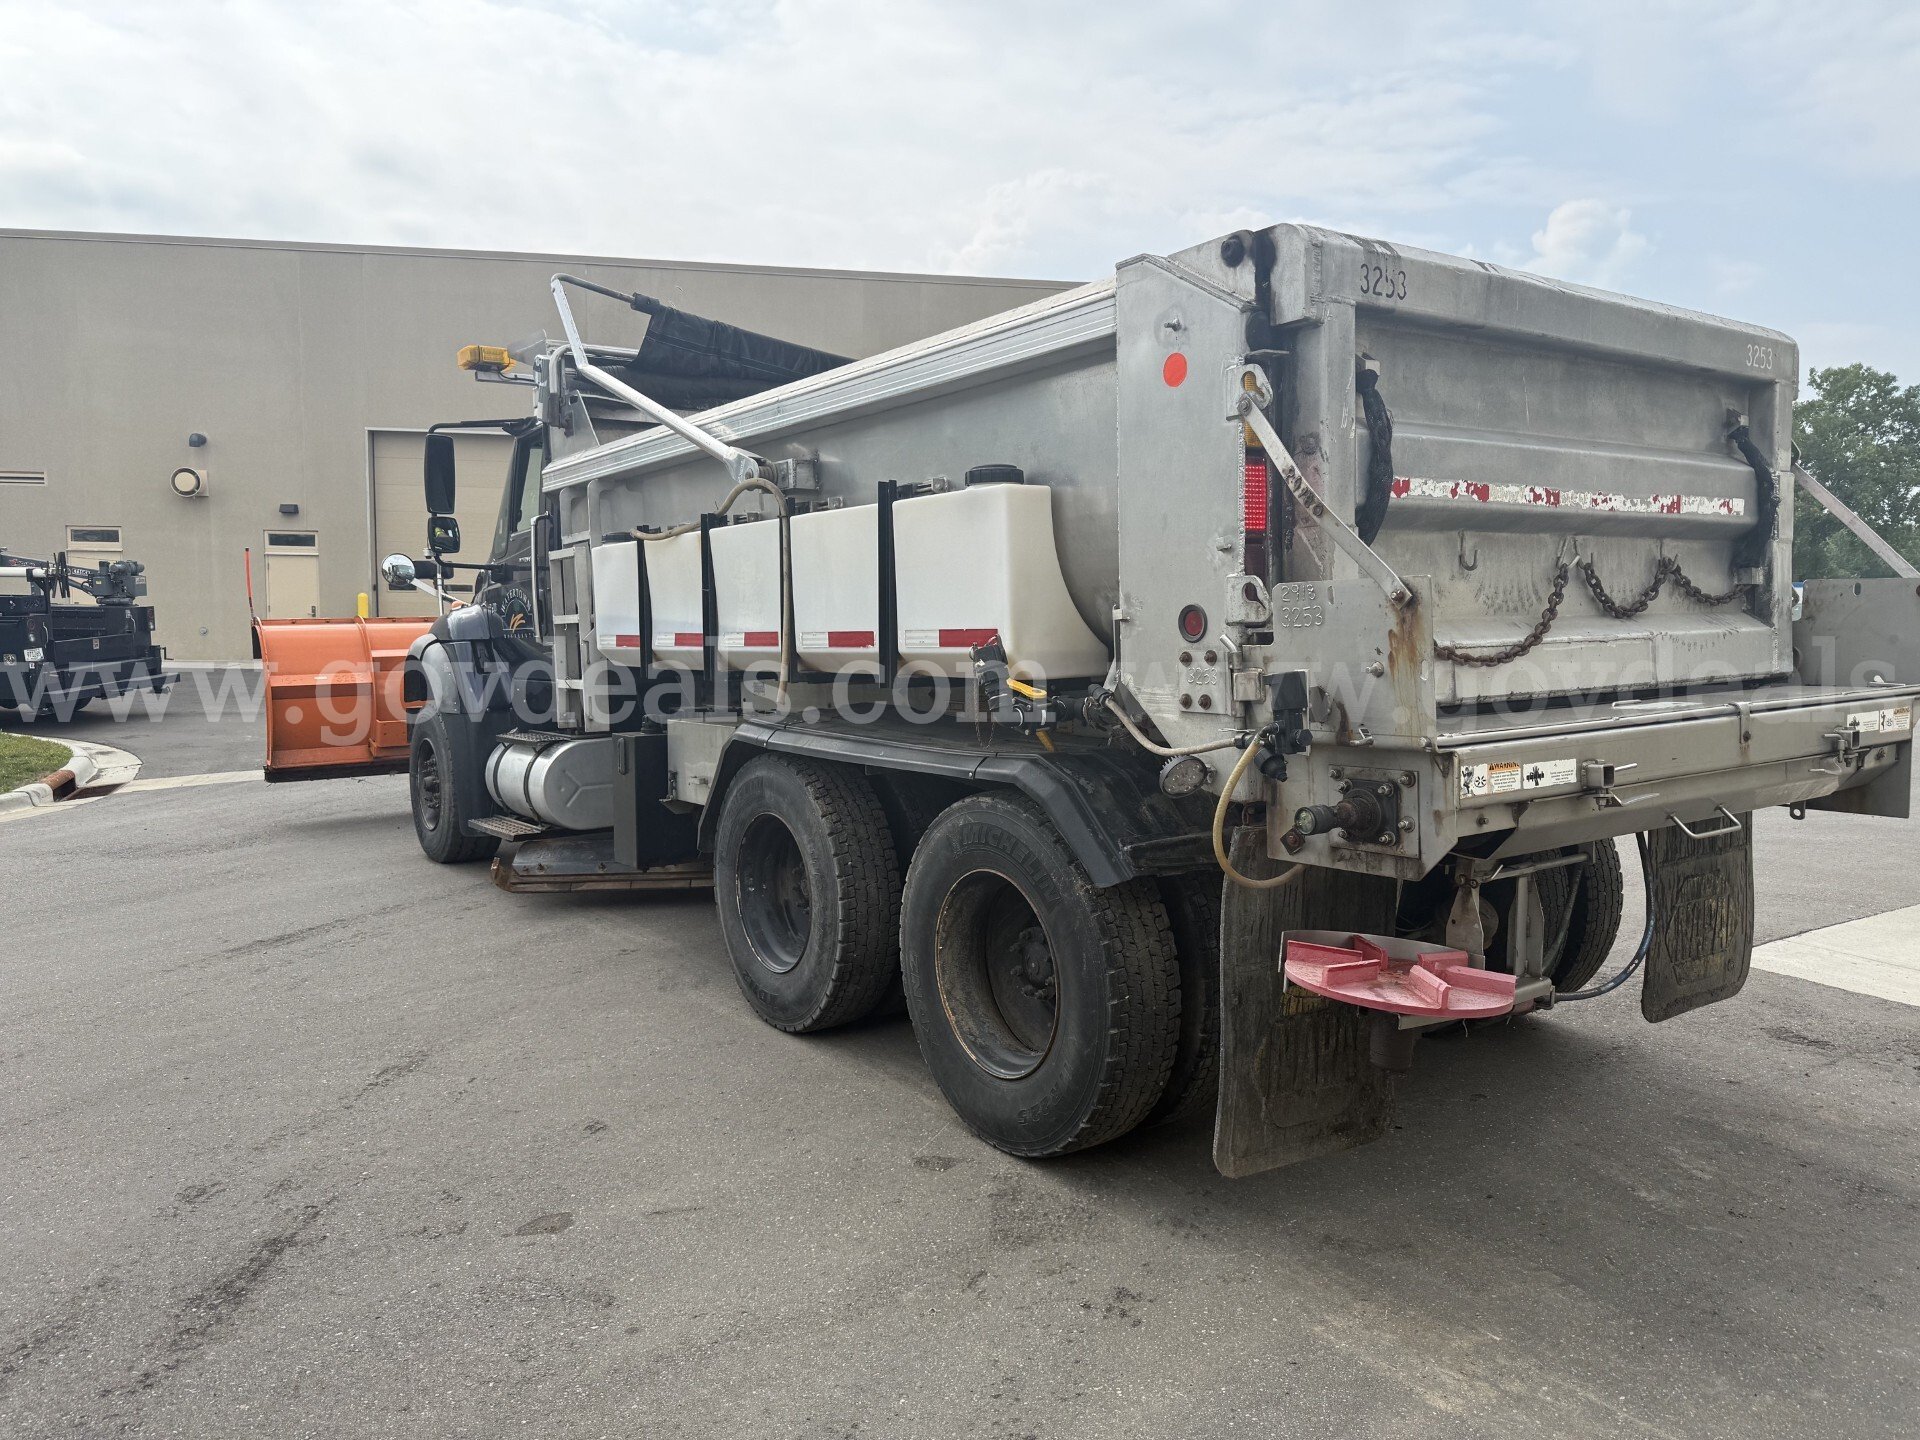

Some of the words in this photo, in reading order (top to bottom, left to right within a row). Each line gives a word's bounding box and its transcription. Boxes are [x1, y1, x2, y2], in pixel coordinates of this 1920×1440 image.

[1360, 263, 1407, 300] 3253
[1746, 343, 1773, 370] 3253
[1281, 605, 1323, 627] 3253
[1187, 667, 1217, 685] 3253
